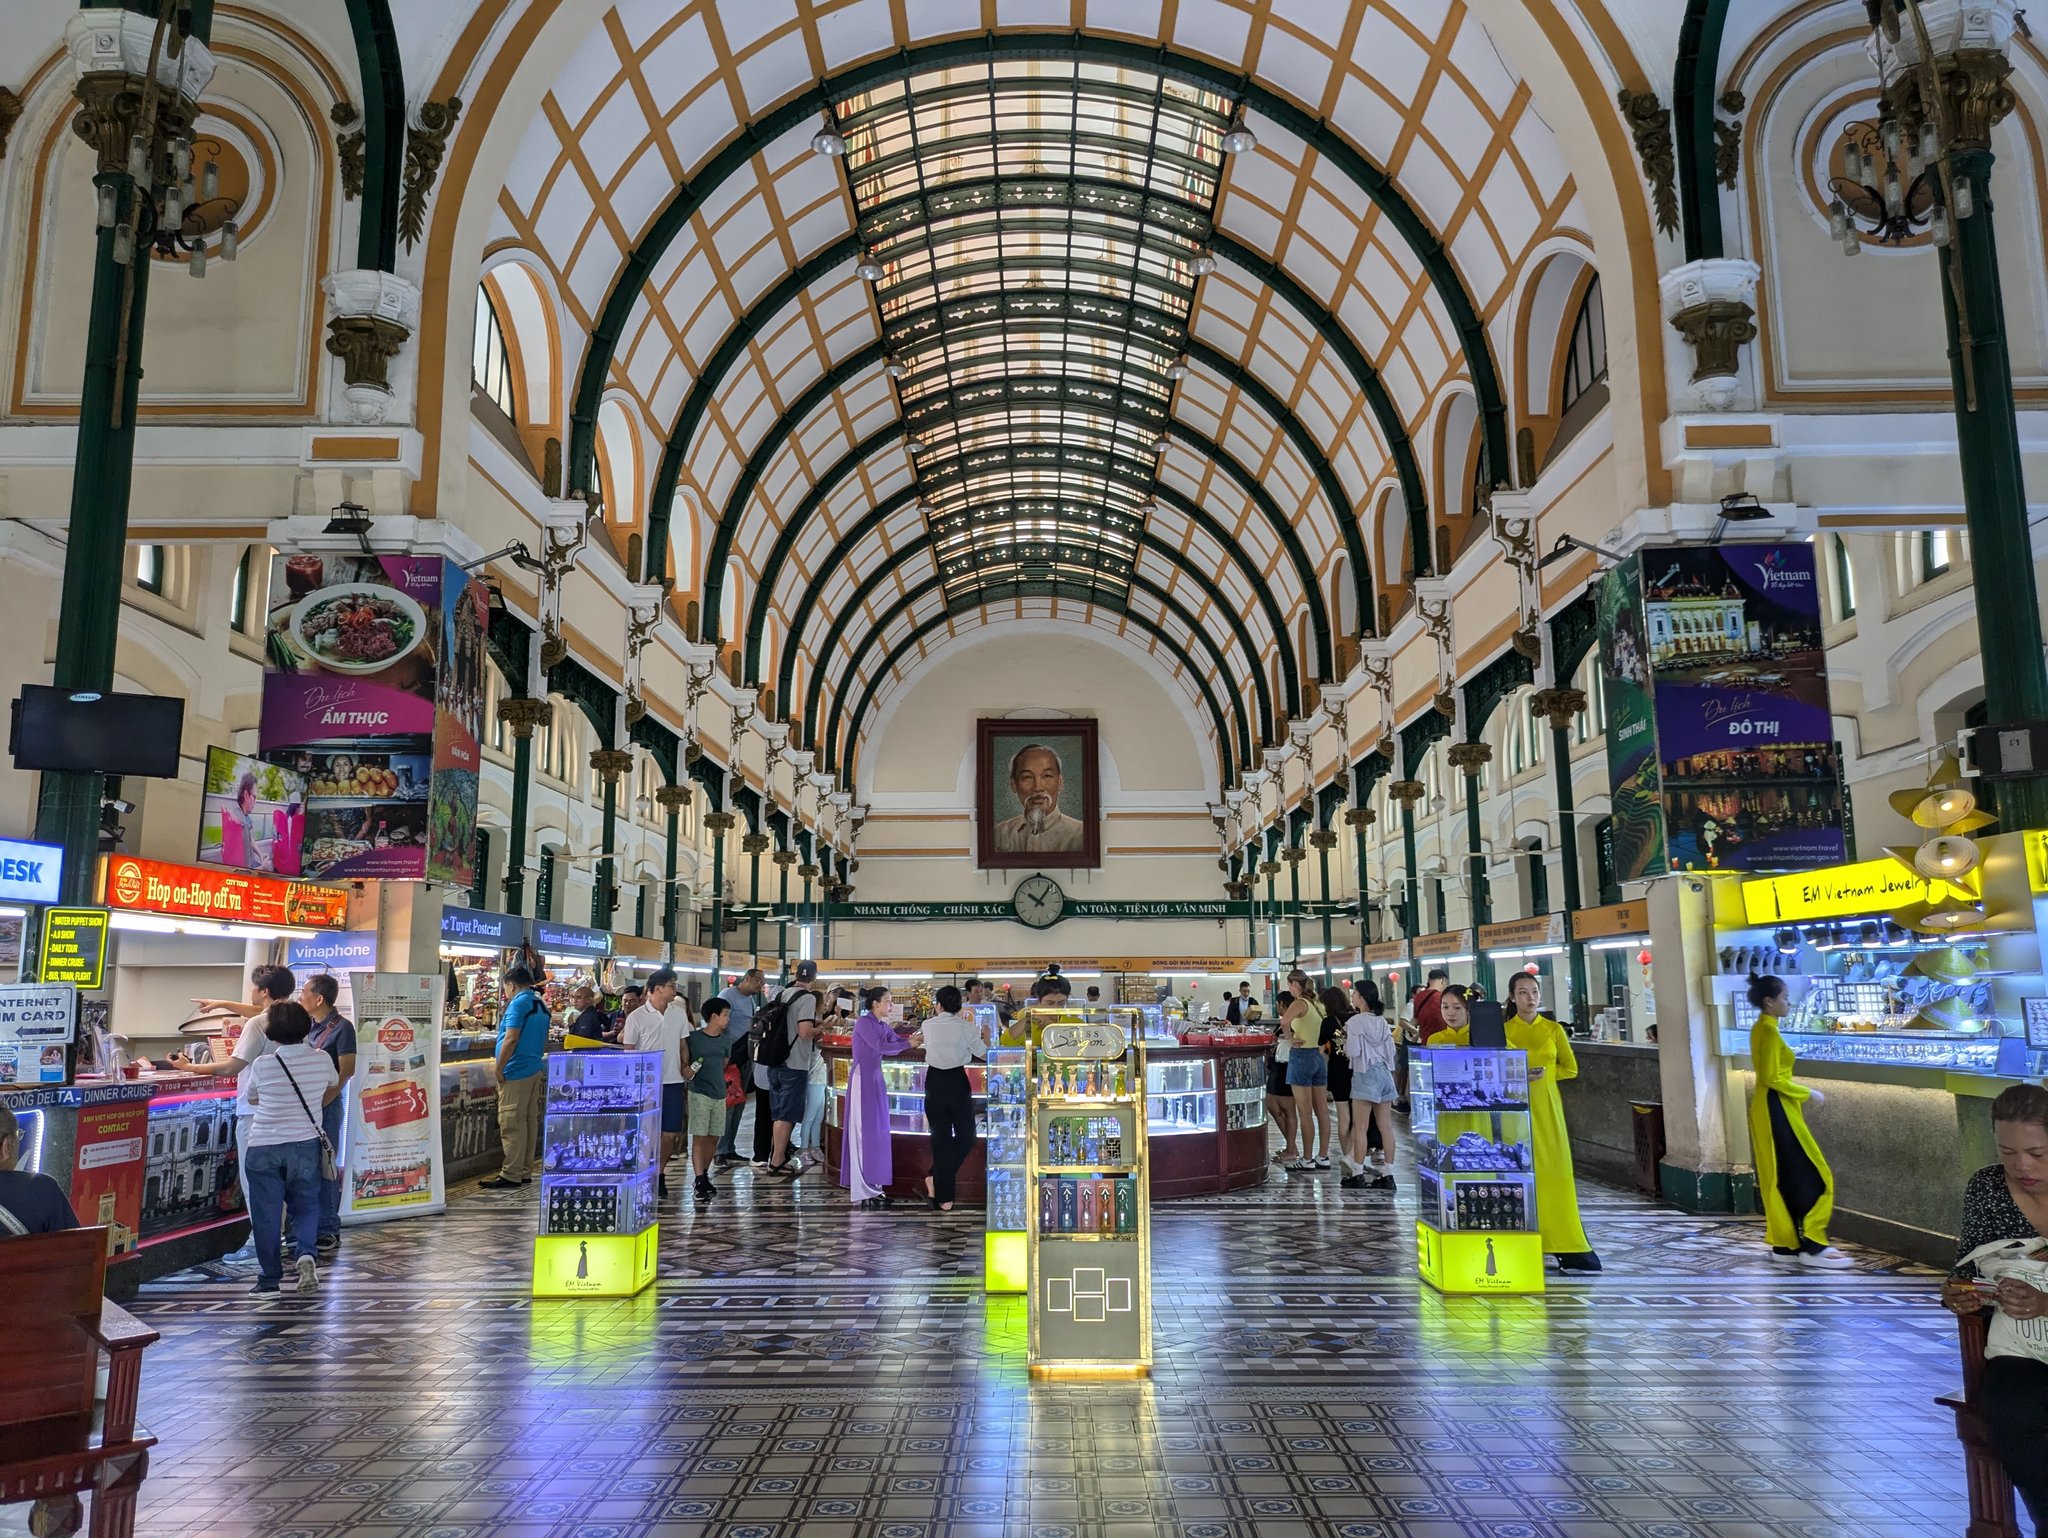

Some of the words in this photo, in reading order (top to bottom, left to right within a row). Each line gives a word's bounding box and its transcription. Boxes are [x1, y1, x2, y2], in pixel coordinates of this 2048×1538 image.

[402, 569, 438, 588] Vietnam
[1753, 563, 1811, 590] Vietnam
[321, 706, 347, 724] ẨM
[349, 711, 389, 727] THỰC
[1618, 725, 1632, 741] SINH
[1632, 716, 1646, 735] THÁI
[1728, 719, 1752, 735] ĐÔ
[1754, 721, 1780, 737] THỊ
[1746, 854, 1839, 862] www.vietnamtourism.gov.vn
[0, 858, 44, 883] ESK
[236, 880, 248, 888] TOUR
[148, 877, 171, 909] Hop
[173, 883, 212, 913] on-Hop
[214, 886, 242, 911] off.vn
[1803, 884, 1821, 904] EM
[1825, 881, 1875, 901] Vietnam
[854, 906, 890, 915] NHANH
[893, 904, 931, 915] CHÓNG
[943, 903, 979, 914] CHÍNH
[983, 902, 1006, 914] XÁC
[1074, 905, 1088, 914] AN
[1089, 903, 1117, 914] TOÀN
[1124, 903, 1148, 915] TIỆN
[1151, 904, 1168, 915] LỢI
[1176, 903, 1197, 914] VĂN
[1199, 905, 1226, 913] MINH
[71, 917, 88, 926] PUPPET
[89, 918, 103, 926] SHOW
[450, 916, 472, 936] Tuyet
[472, 920, 502, 936] Postcard
[60, 930, 75, 939] SHOW
[540, 930, 561, 944] Vietnam
[562, 932, 587, 947] Handmade
[66, 944, 78, 952] TOUR
[296, 944, 370, 958] vinaphone
[68, 958, 84, 967] CRUISE
[75, 972, 92, 981] FLIGHT
[21, 1011, 66, 1020] CARD
[1051, 1027, 1106, 1056] Saigon
[84, 1088, 118, 1102] DINNER
[120, 1084, 153, 1098] CRUISE
[98, 1122, 130, 1134] CONTACT
